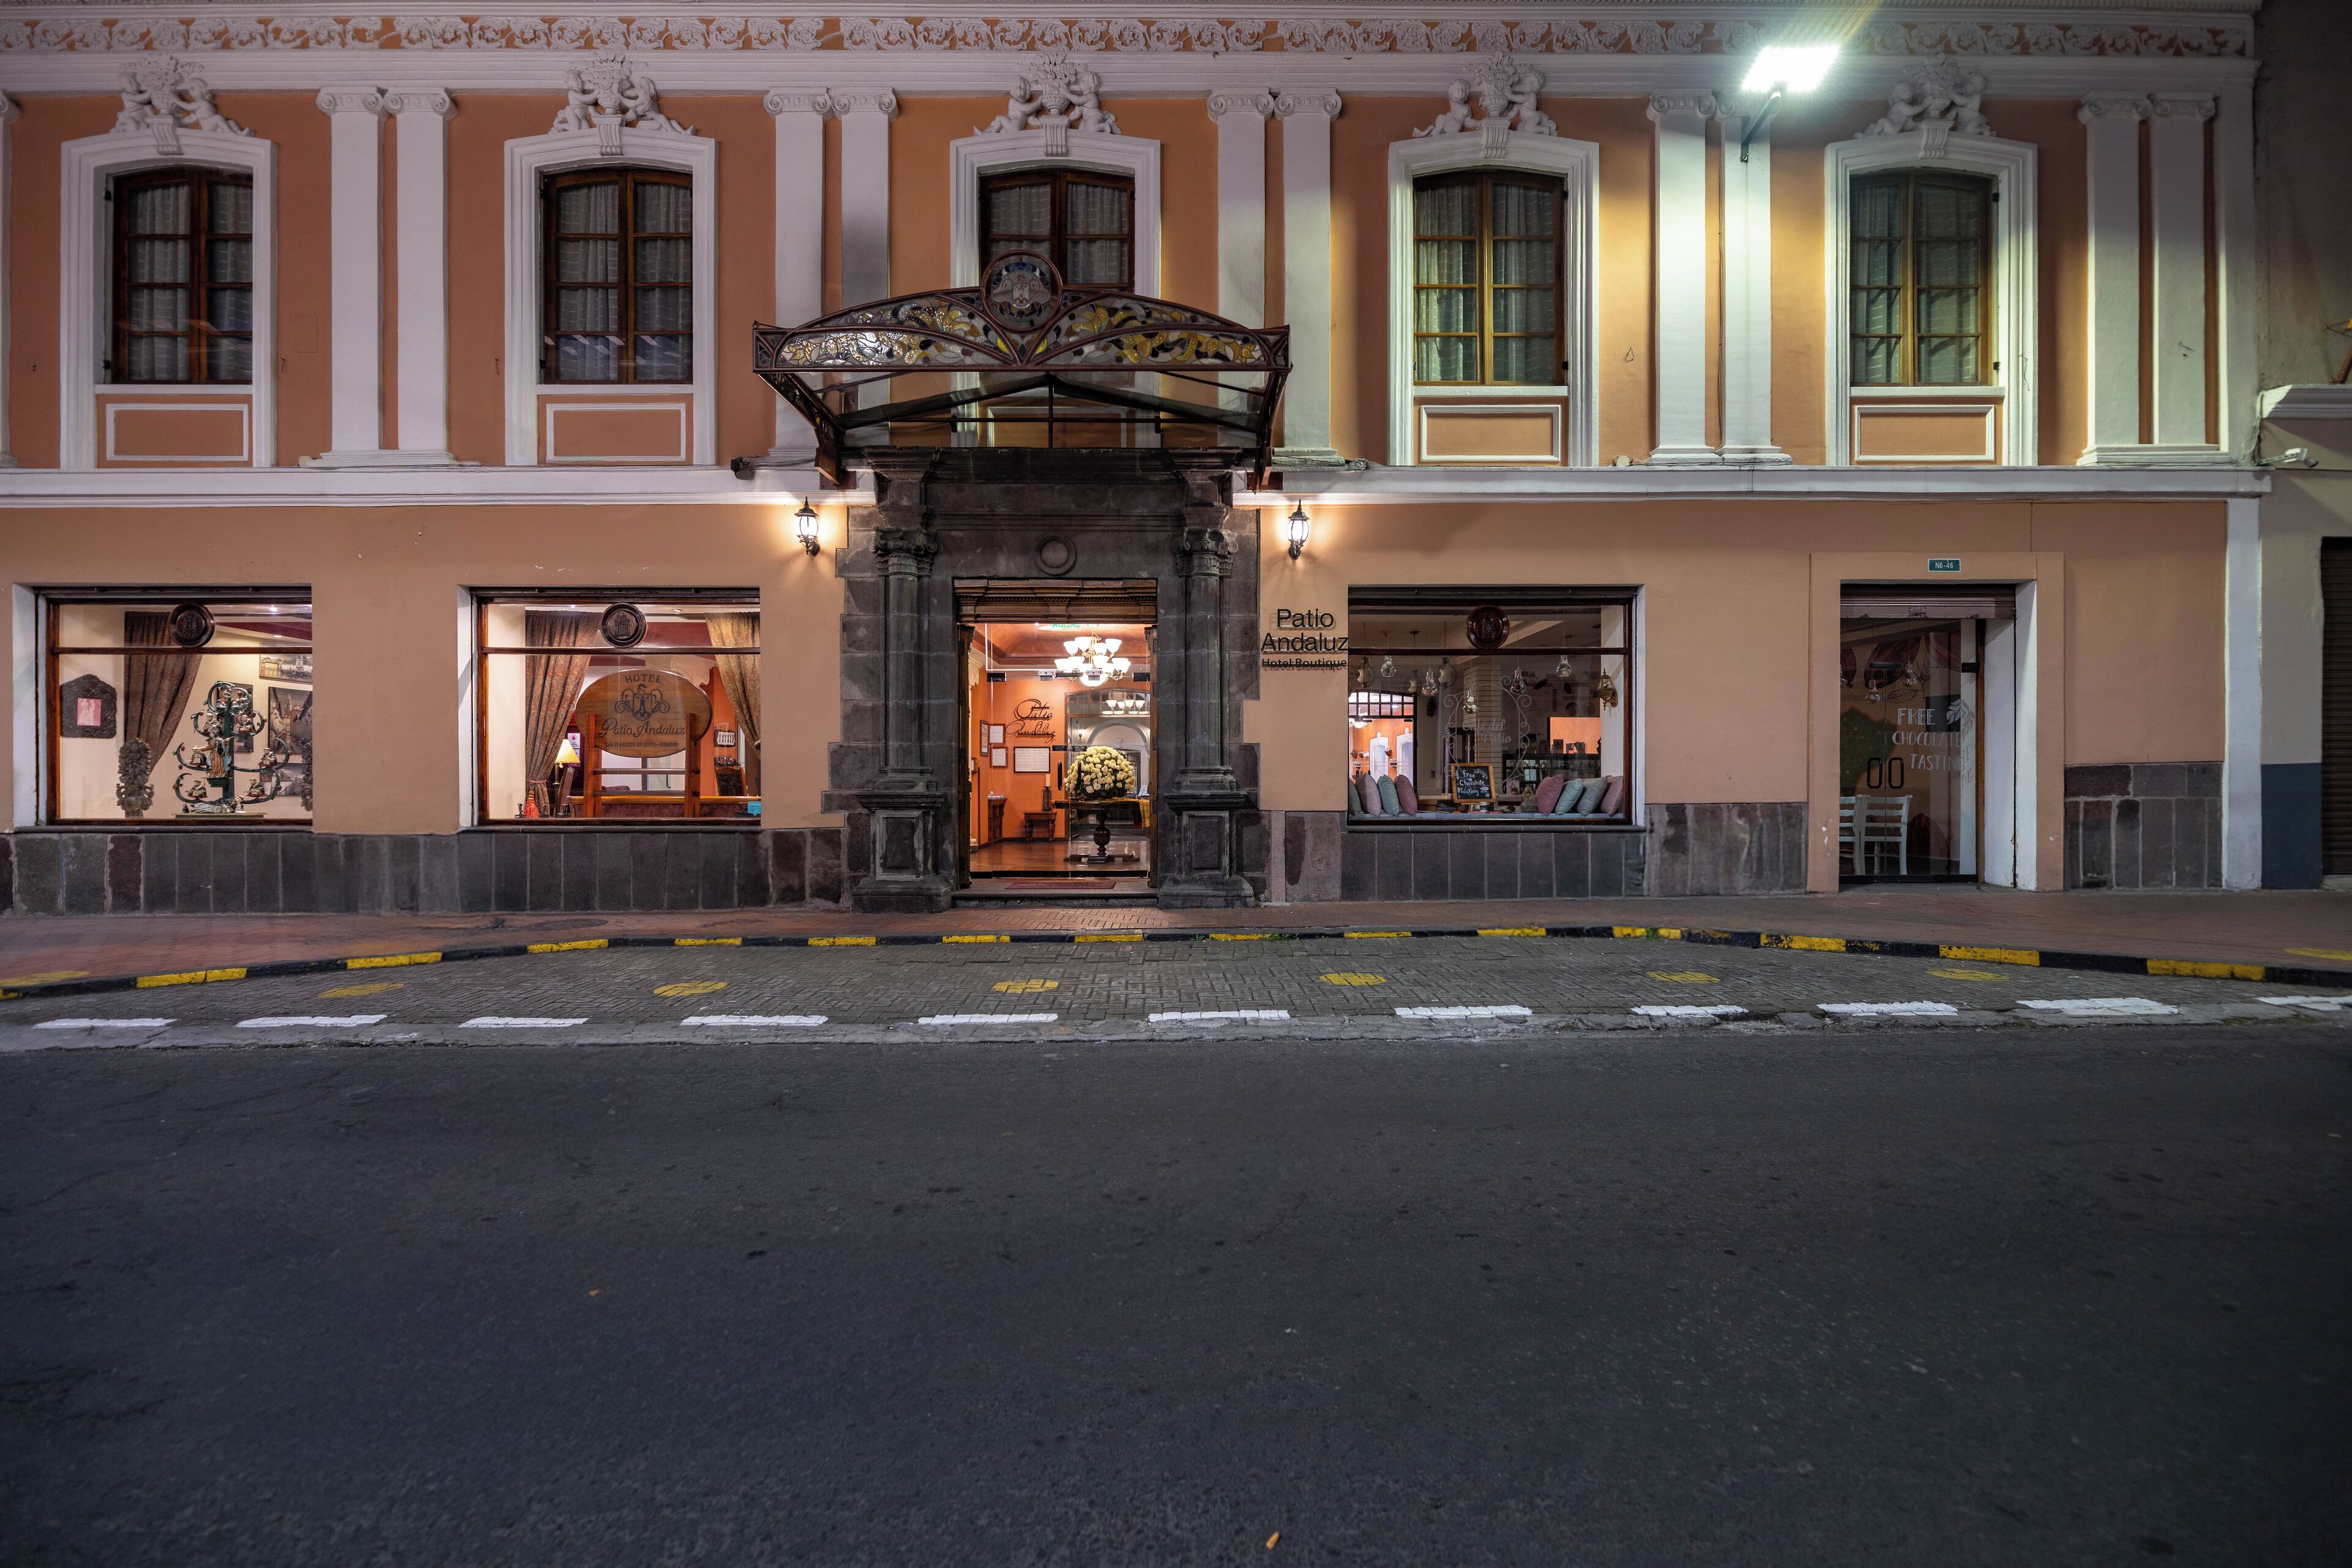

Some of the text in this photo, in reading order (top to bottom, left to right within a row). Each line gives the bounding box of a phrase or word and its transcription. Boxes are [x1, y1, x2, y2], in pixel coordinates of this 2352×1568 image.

[1277, 608, 1334, 627] Patio
[1261, 633, 1349, 652] Andaluz
[1262, 658, 1347, 669] Hotel Boutique
[625, 674, 661, 684] HOTEL
[1014, 699, 1054, 719] Patio
[1898, 708, 1936, 725] FREE
[598, 718, 685, 737] Patio Andaluz
[1891, 731, 1962, 747] CHOCOLATE
[1910, 753, 1966, 772] TASTING
